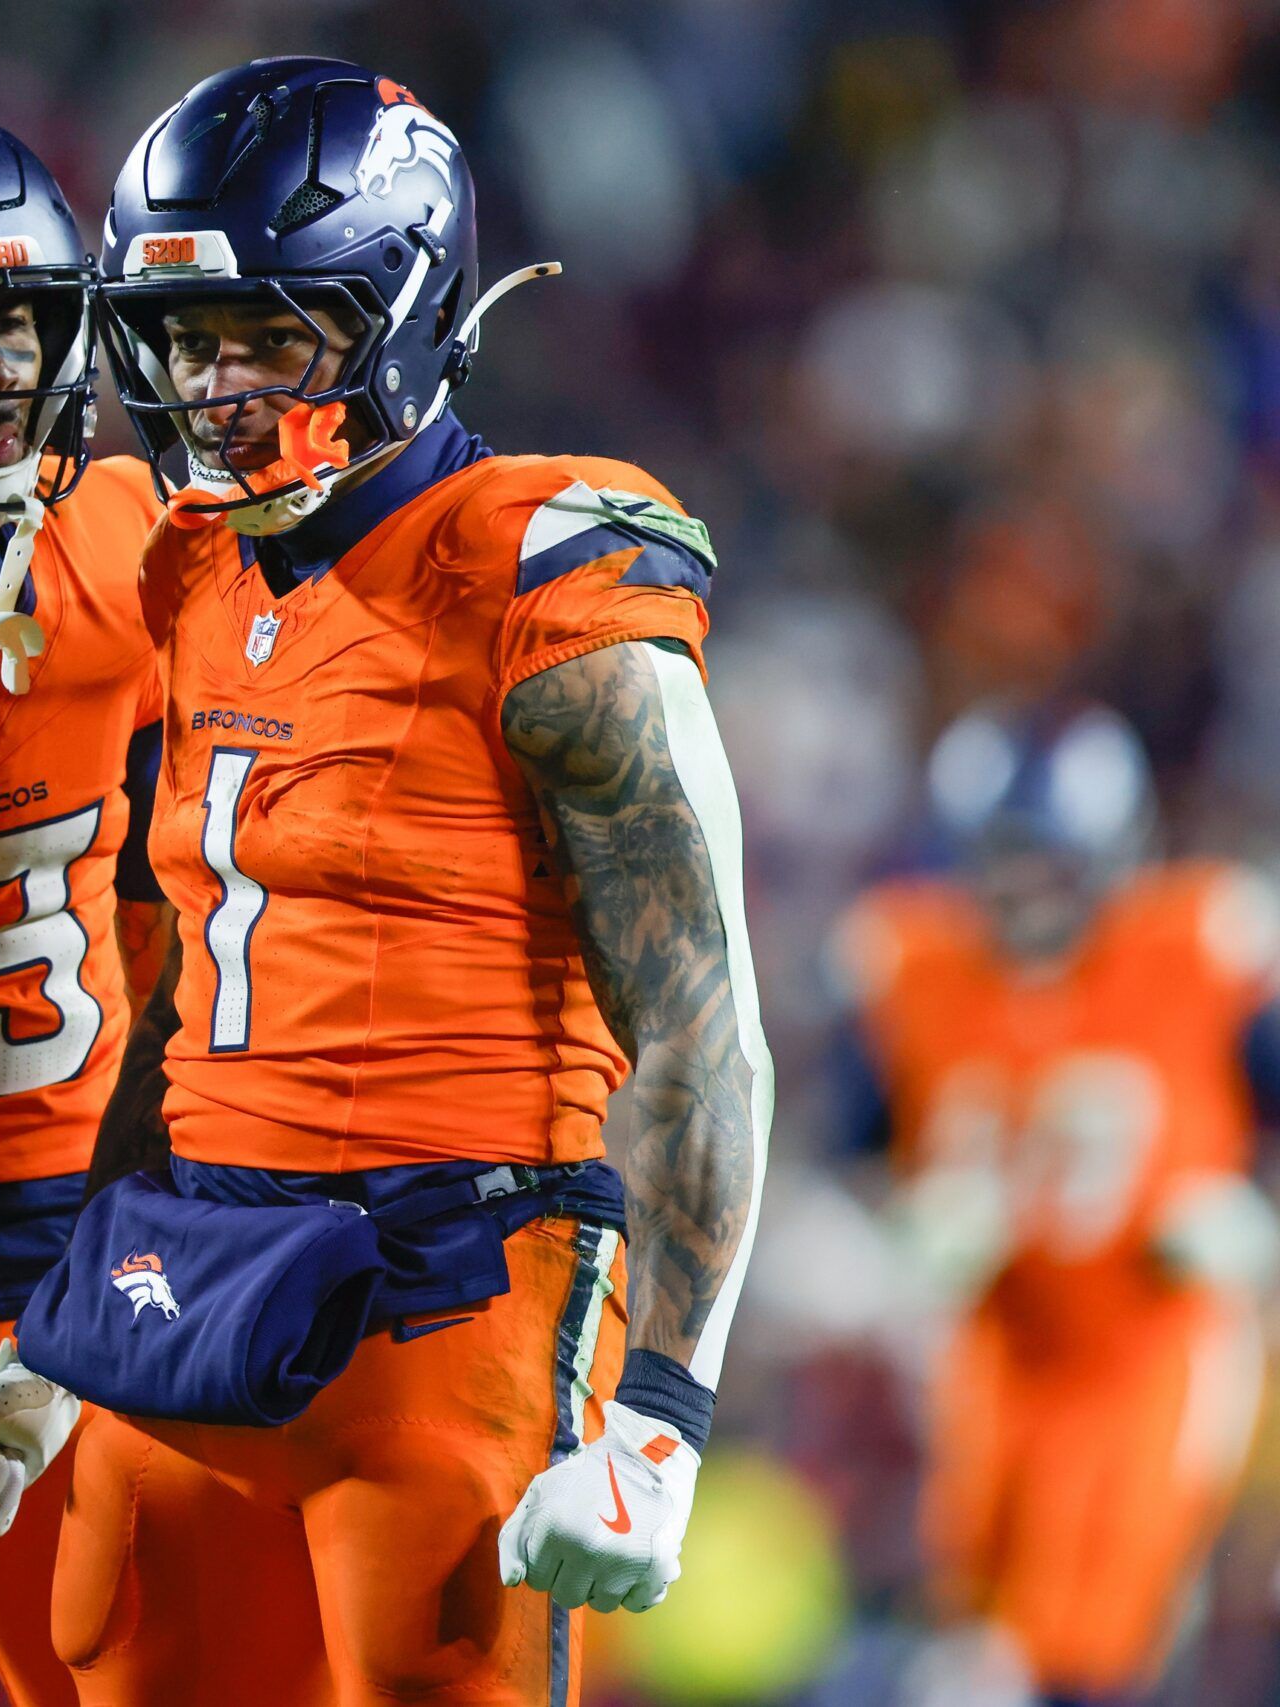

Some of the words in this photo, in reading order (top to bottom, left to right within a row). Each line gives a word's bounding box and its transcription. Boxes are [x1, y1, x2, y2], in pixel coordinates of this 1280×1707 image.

[143, 237, 195, 265] 5280
[192, 709, 293, 740] BRONCOS
[201, 745, 268, 1054] 1
